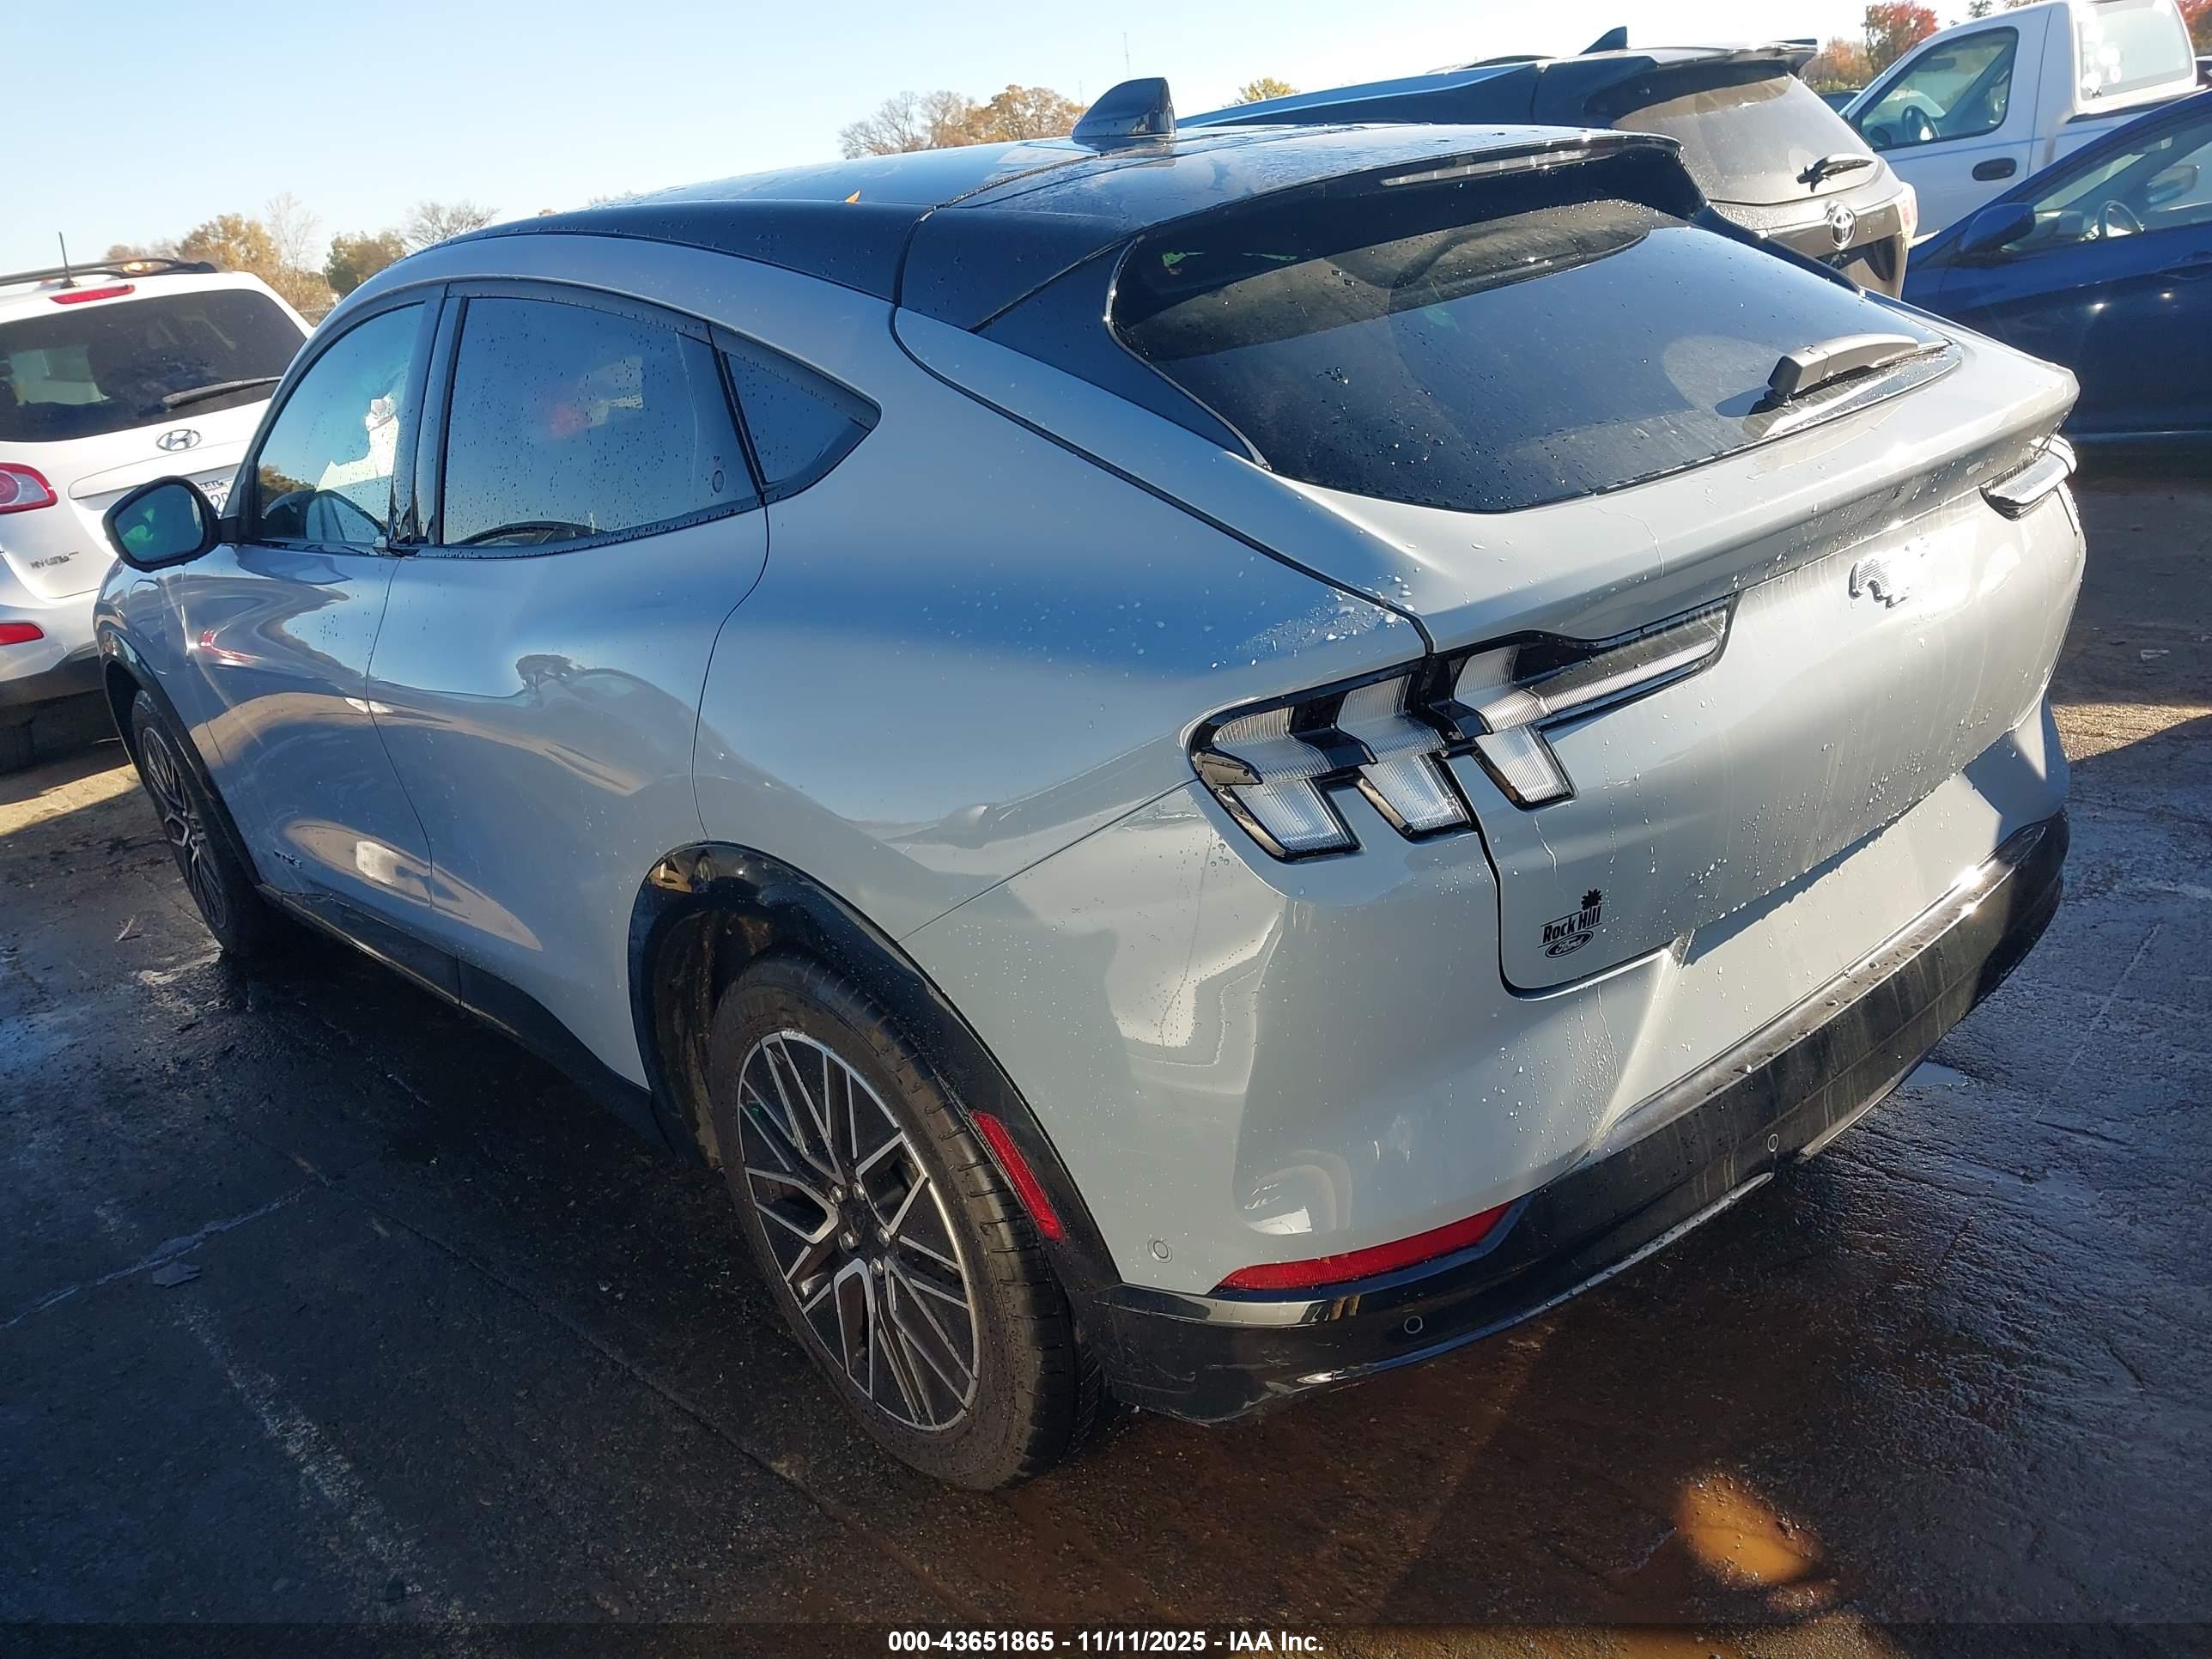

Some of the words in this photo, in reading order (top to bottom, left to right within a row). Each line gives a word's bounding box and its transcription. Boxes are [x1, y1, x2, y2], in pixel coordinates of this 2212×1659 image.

[1542, 916, 1577, 944] Rock
[1577, 906, 1601, 930] Hill
[1554, 934, 1586, 954] Ford
